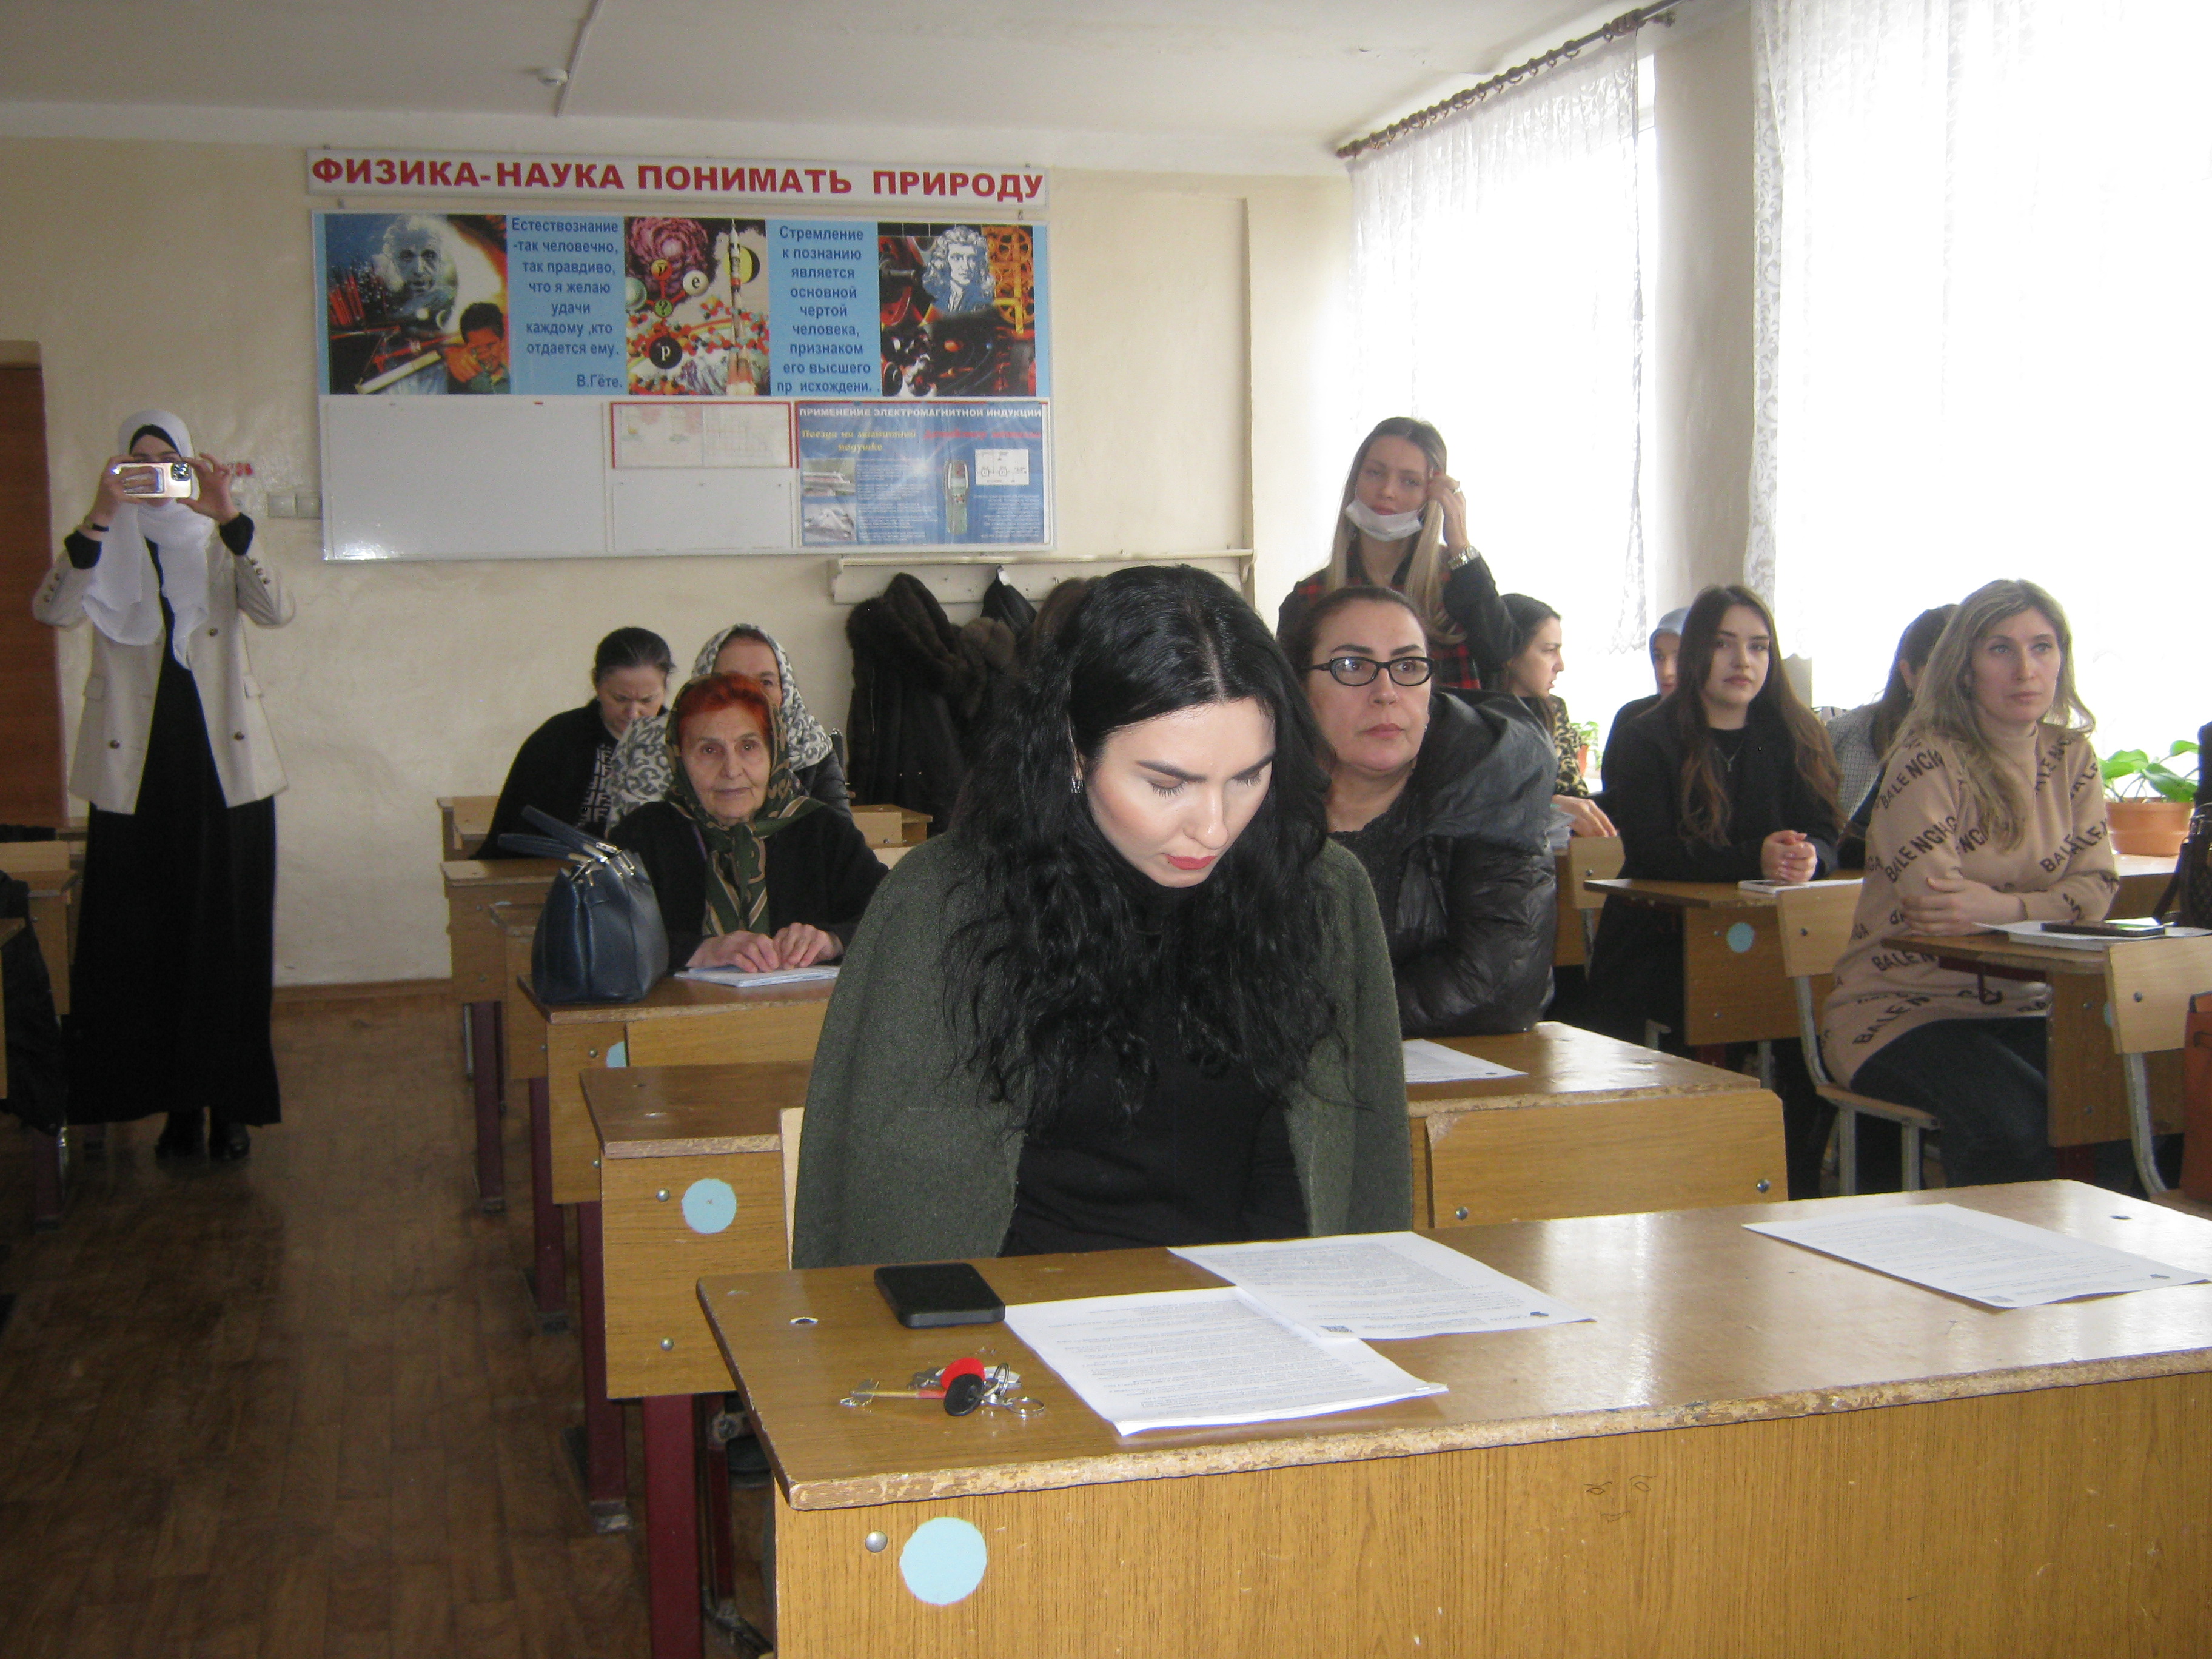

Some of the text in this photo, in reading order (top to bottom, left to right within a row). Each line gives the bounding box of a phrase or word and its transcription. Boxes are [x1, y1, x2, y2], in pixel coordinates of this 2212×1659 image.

[637, 165, 852, 193] ПОНИМАТЬ
[873, 170, 1043, 203] ПРИРОДУ
[511, 218, 618, 233] Естествознание
[780, 226, 863, 242] Стремление
[543, 241, 618, 254] человечно,
[783, 249, 862, 260] к познанию
[522, 261, 615, 275] так правдиво,
[791, 268, 854, 279] является
[529, 282, 611, 293] что я желаю
[790, 286, 857, 298] основной
[552, 303, 591, 317] удачи
[800, 303, 847, 319] чертой
[526, 323, 584, 337] каждому
[792, 325, 859, 337] человека,
[526, 343, 586, 355] отдается
[790, 344, 863, 357] признаком
[783, 363, 871, 374] его высшего
[577, 374, 622, 388] В.Гёте.
[799, 408, 871, 417] ПРИМЕНЕНИЕ
[987, 409, 1041, 418] ИНДУКЦИИ
